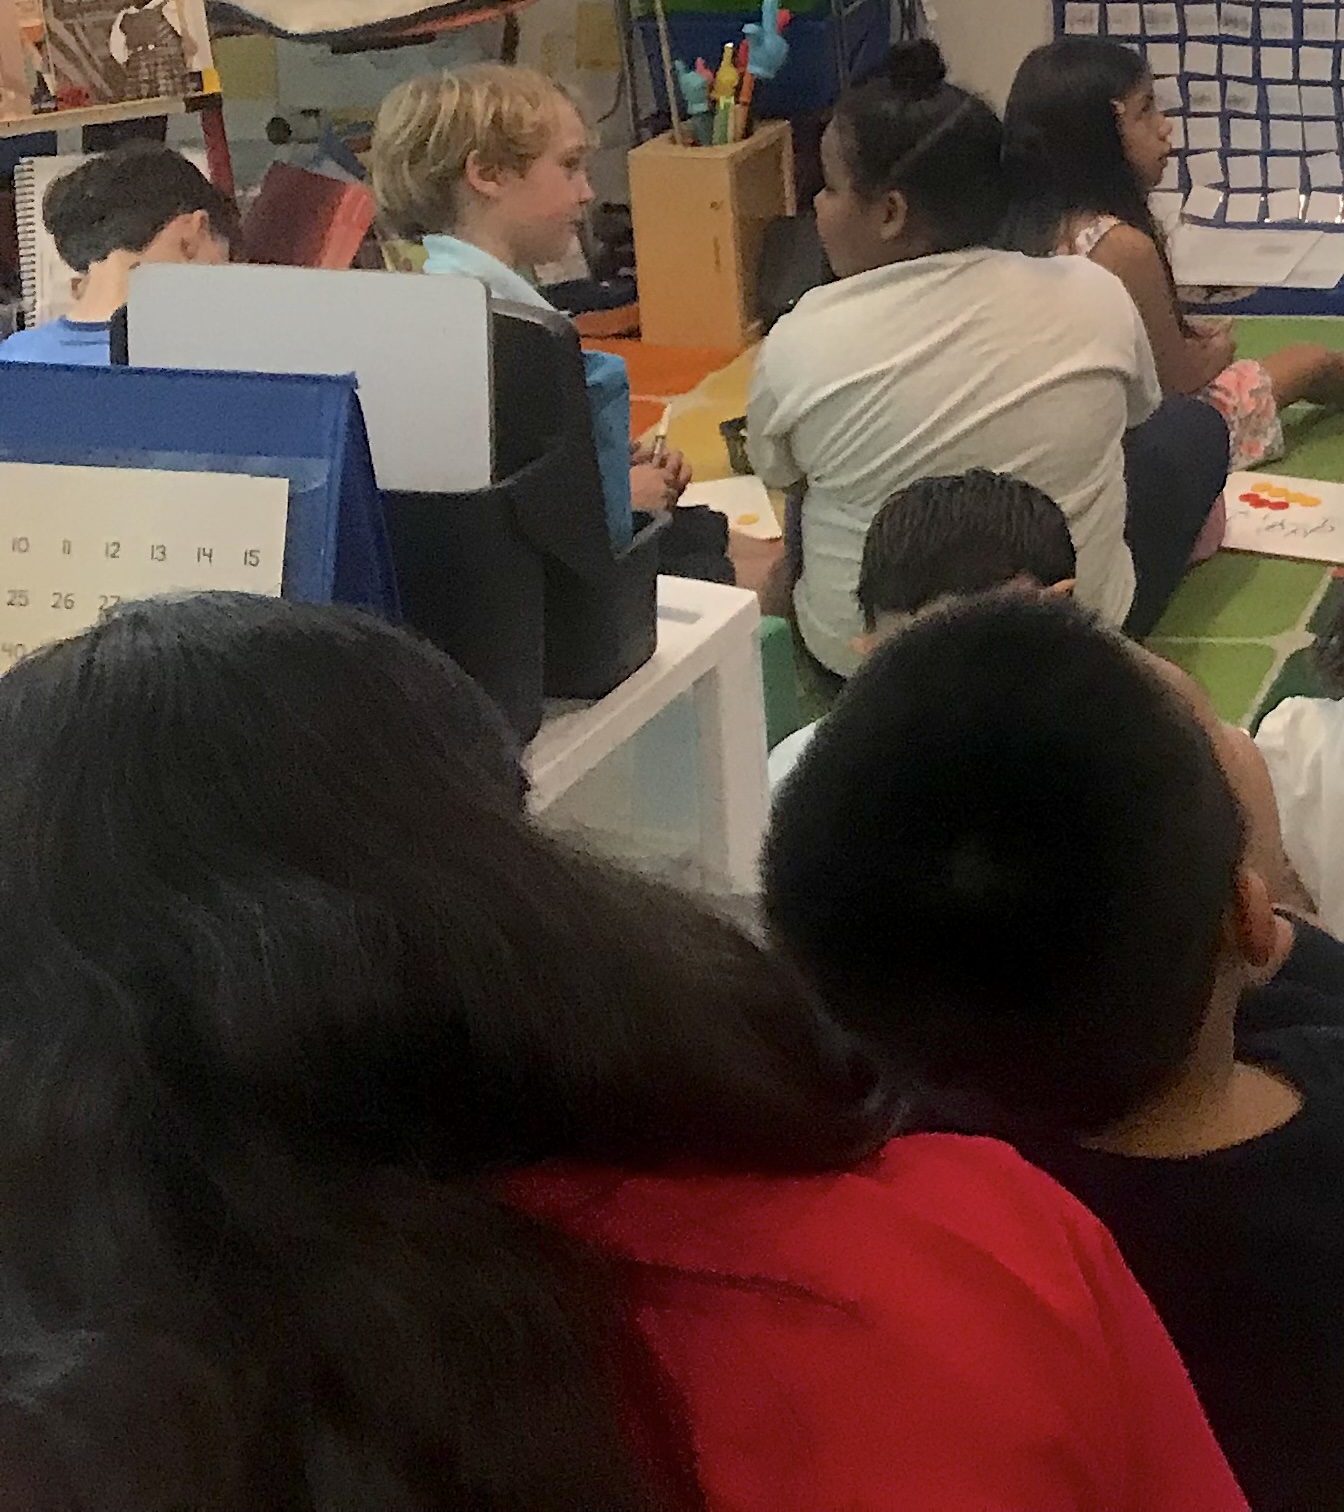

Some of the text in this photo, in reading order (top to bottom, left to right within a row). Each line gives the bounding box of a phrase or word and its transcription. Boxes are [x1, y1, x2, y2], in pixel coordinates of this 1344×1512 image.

[105, 541, 260, 567] 12 13 14 15
[7, 590, 75, 609] 25 26
